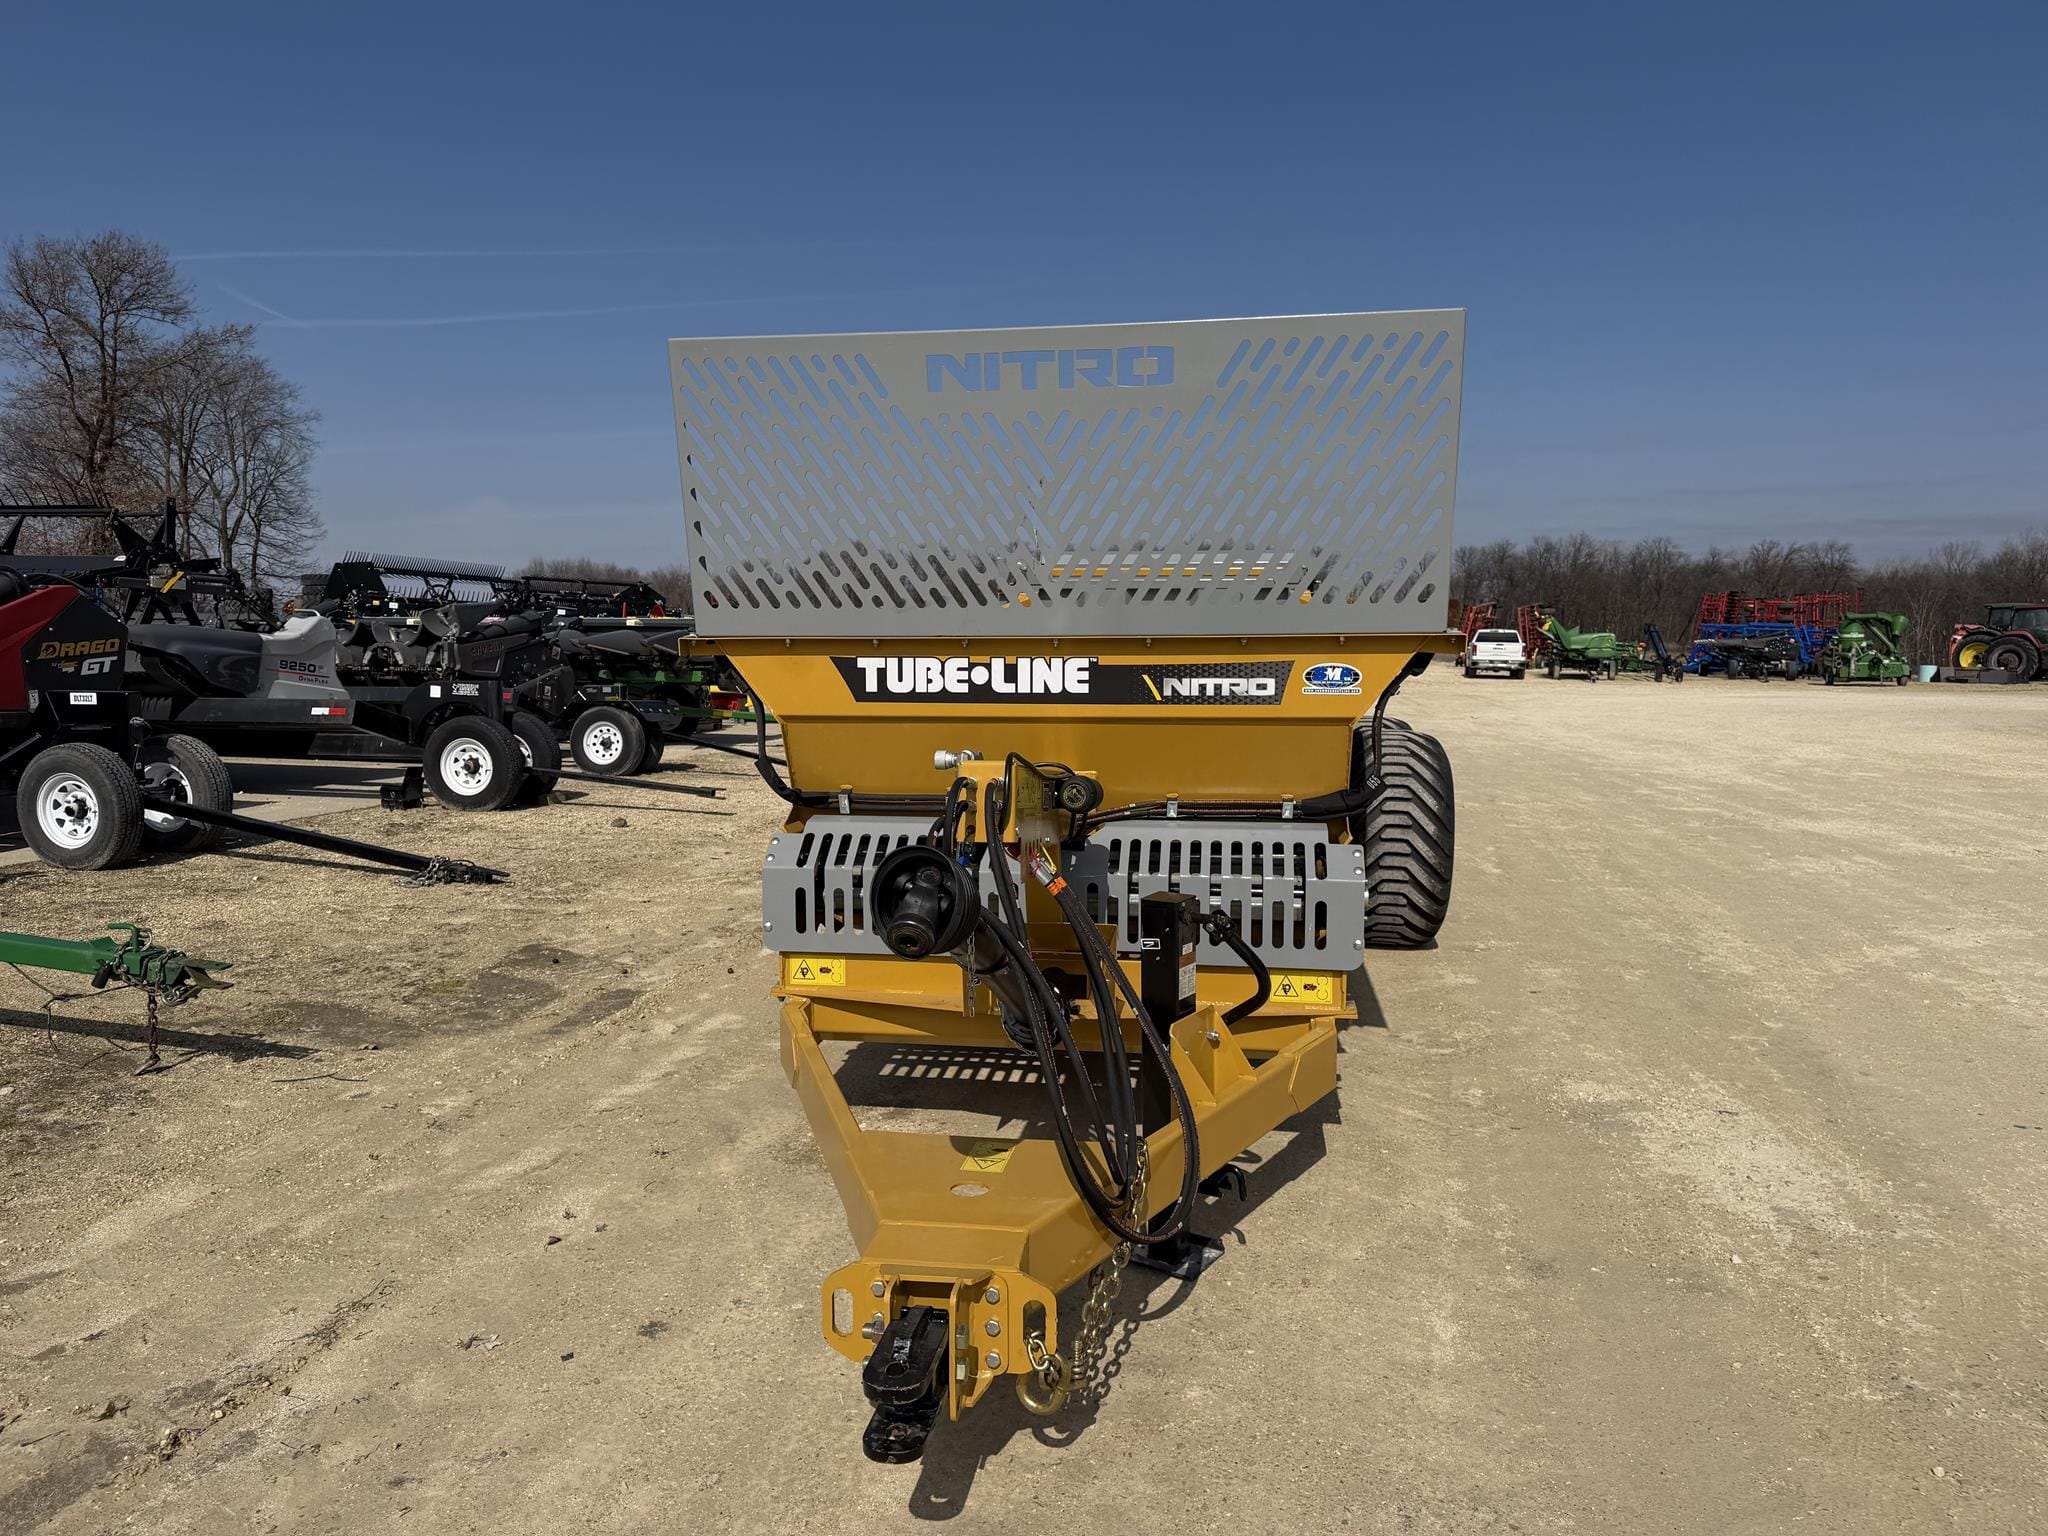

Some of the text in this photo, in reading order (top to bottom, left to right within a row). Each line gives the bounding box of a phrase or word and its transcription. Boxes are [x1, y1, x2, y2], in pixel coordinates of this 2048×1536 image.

[926, 345, 1175, 393] NITRO
[37, 638, 120, 659] DRAGO
[80, 656, 118, 675] GT
[279, 660, 316, 673] 9250
[1163, 677, 1276, 697] NITRO
